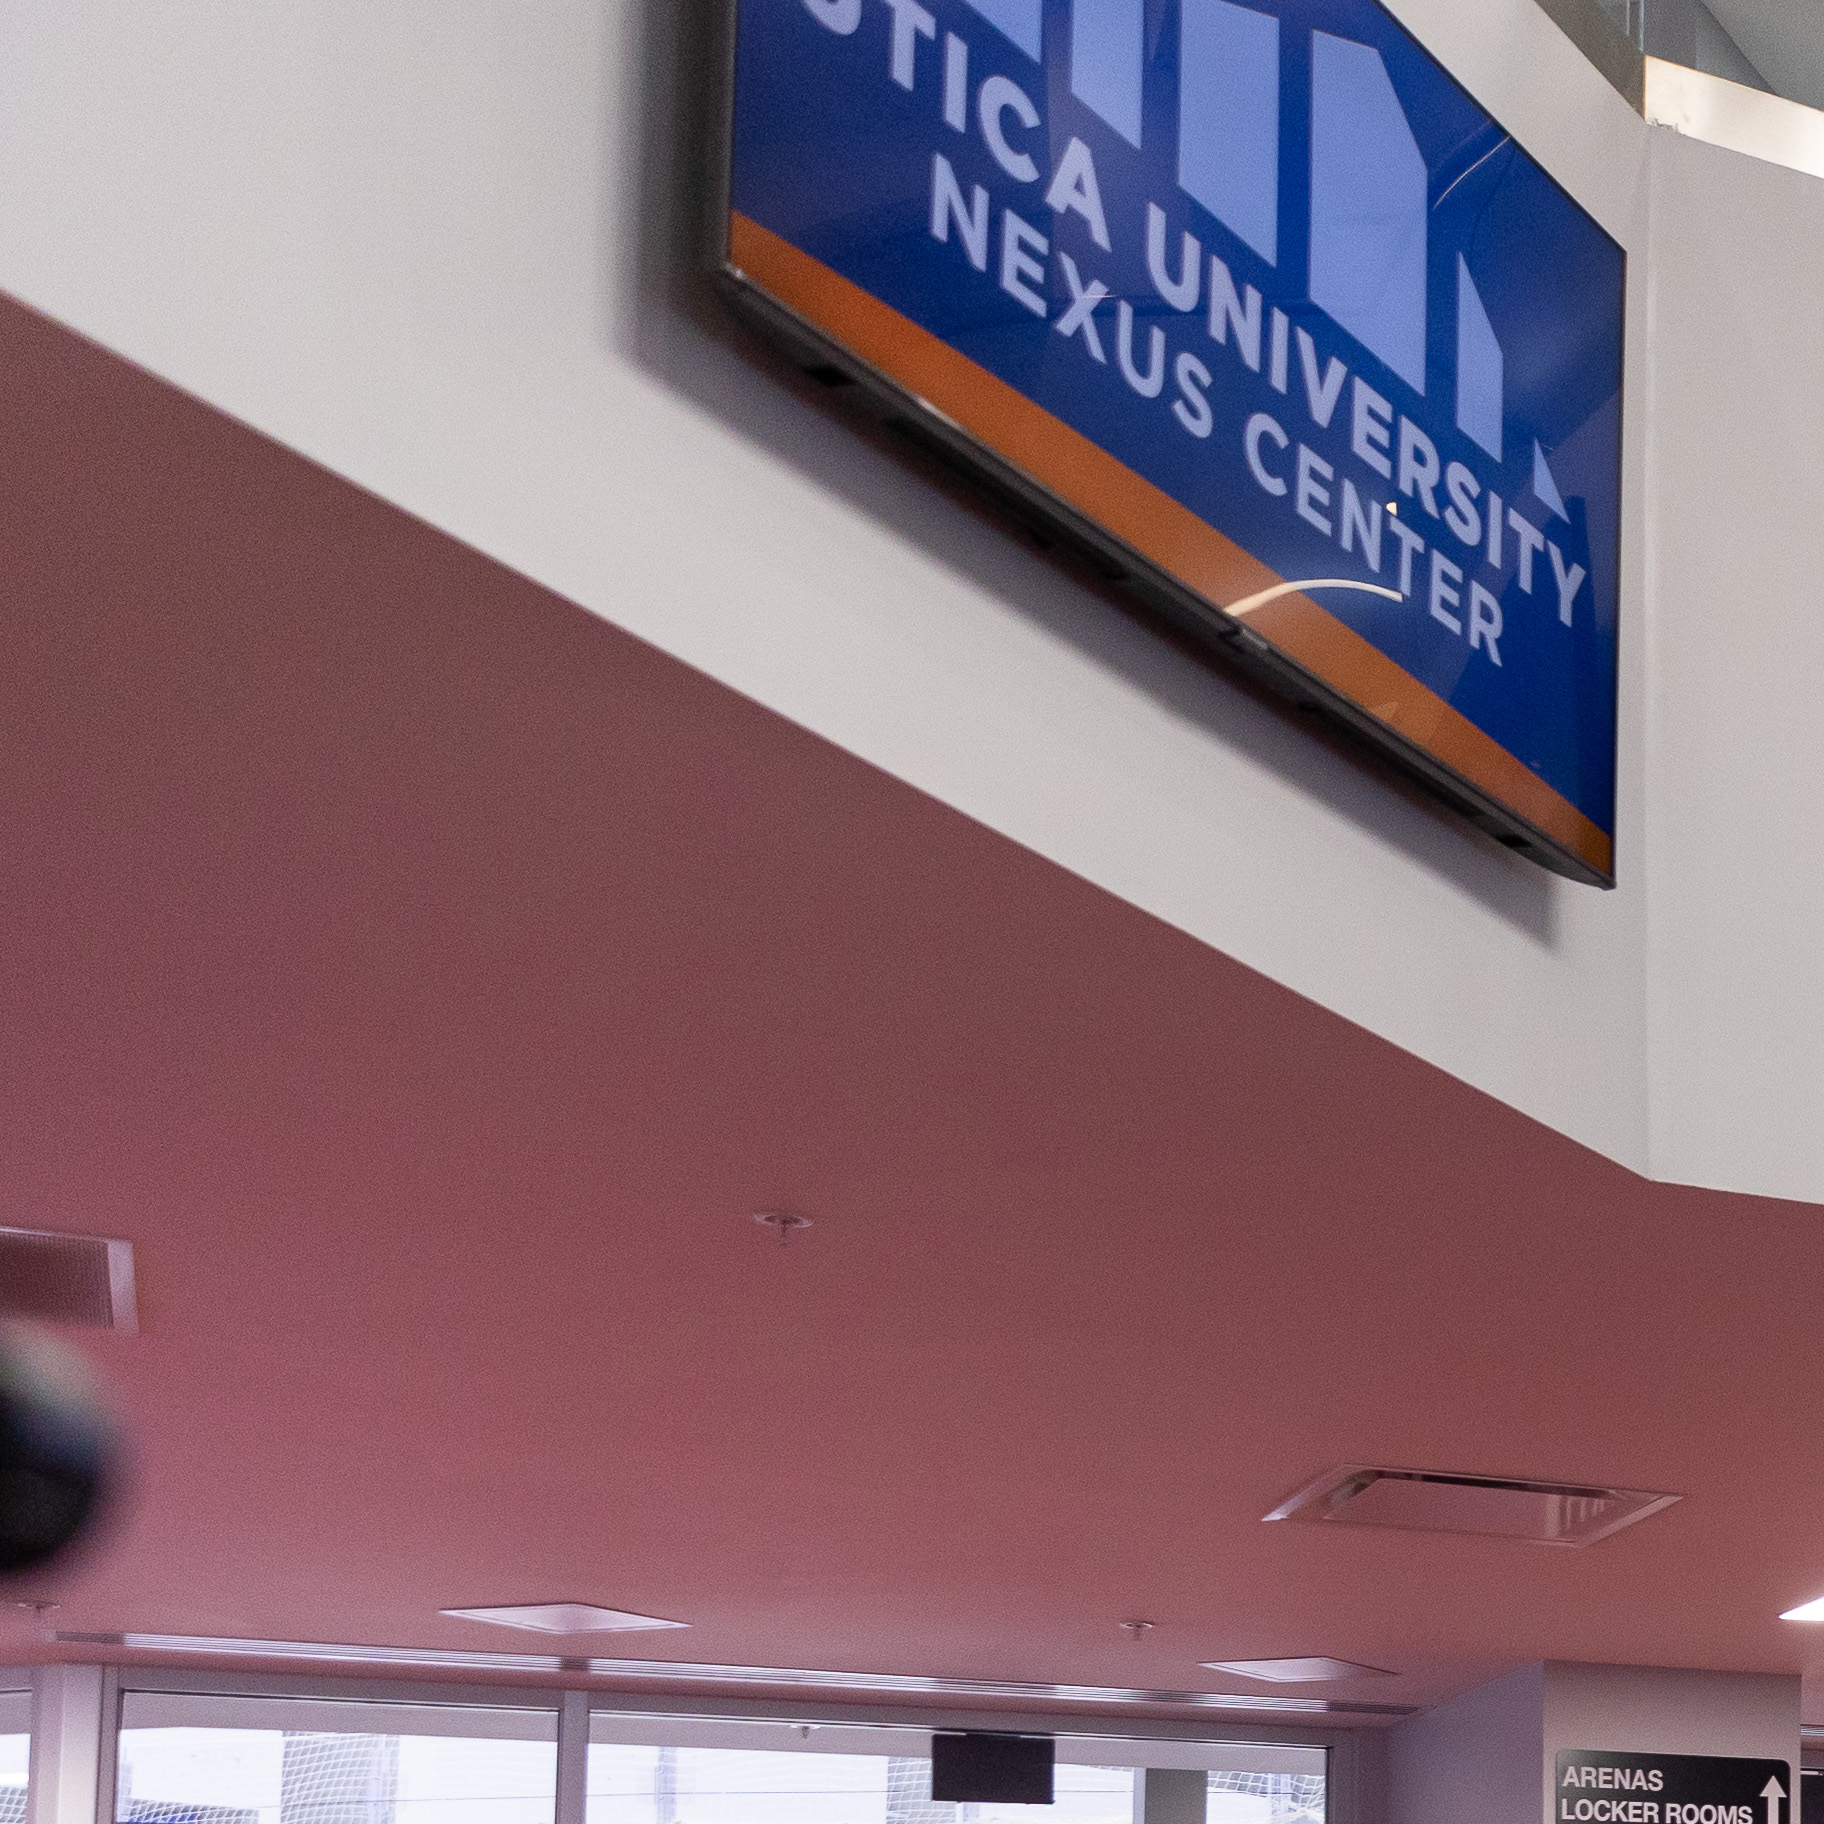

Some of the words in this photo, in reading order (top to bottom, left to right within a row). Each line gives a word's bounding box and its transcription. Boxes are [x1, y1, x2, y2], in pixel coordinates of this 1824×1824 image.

[930, 151, 1213, 440] NEXUS
[1244, 411, 1503, 667] CENTER
[1147, 202, 1587, 628] UNIVERSITY
[1560, 1798, 1660, 1824] LOCKER
[1561, 1765, 1664, 1792] ARENAS
